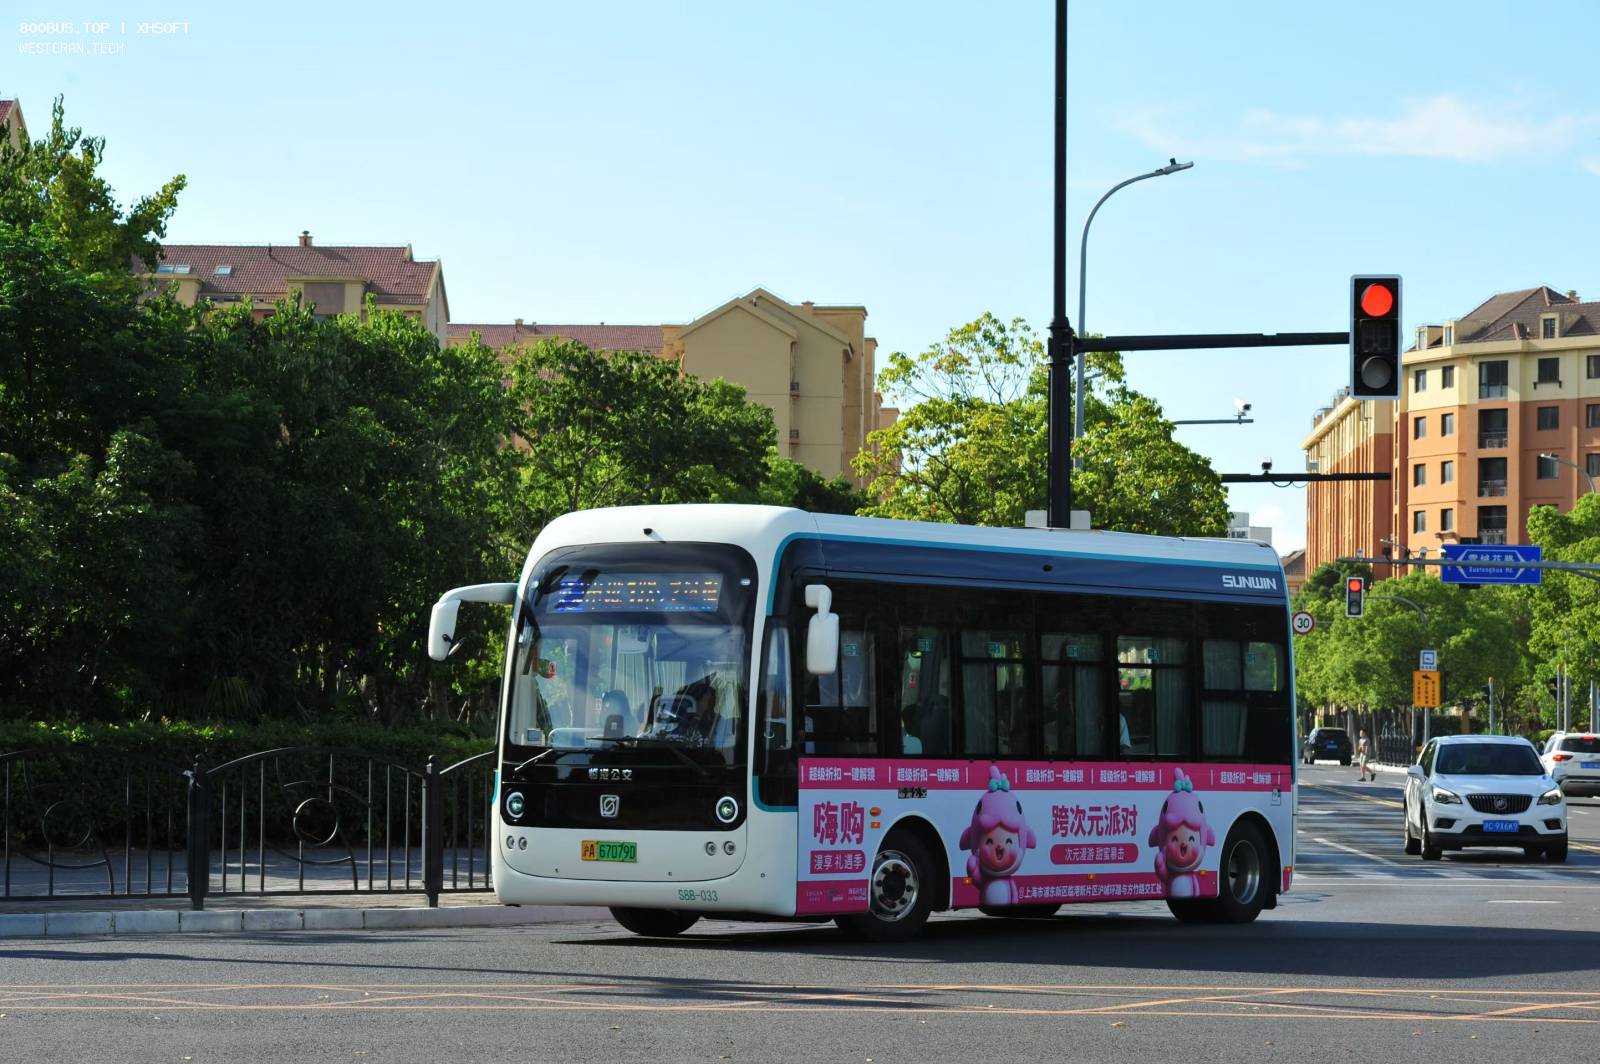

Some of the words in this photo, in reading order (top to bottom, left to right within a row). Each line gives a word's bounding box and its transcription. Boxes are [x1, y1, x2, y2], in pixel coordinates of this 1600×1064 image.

[1222, 575, 1277, 590] SUNWIN
[1297, 617, 1310, 629] 30
[814, 801, 865, 845] 嗨购
[1052, 804, 1138, 837] 跨次元派对
[815, 854, 833, 870] 漫享
